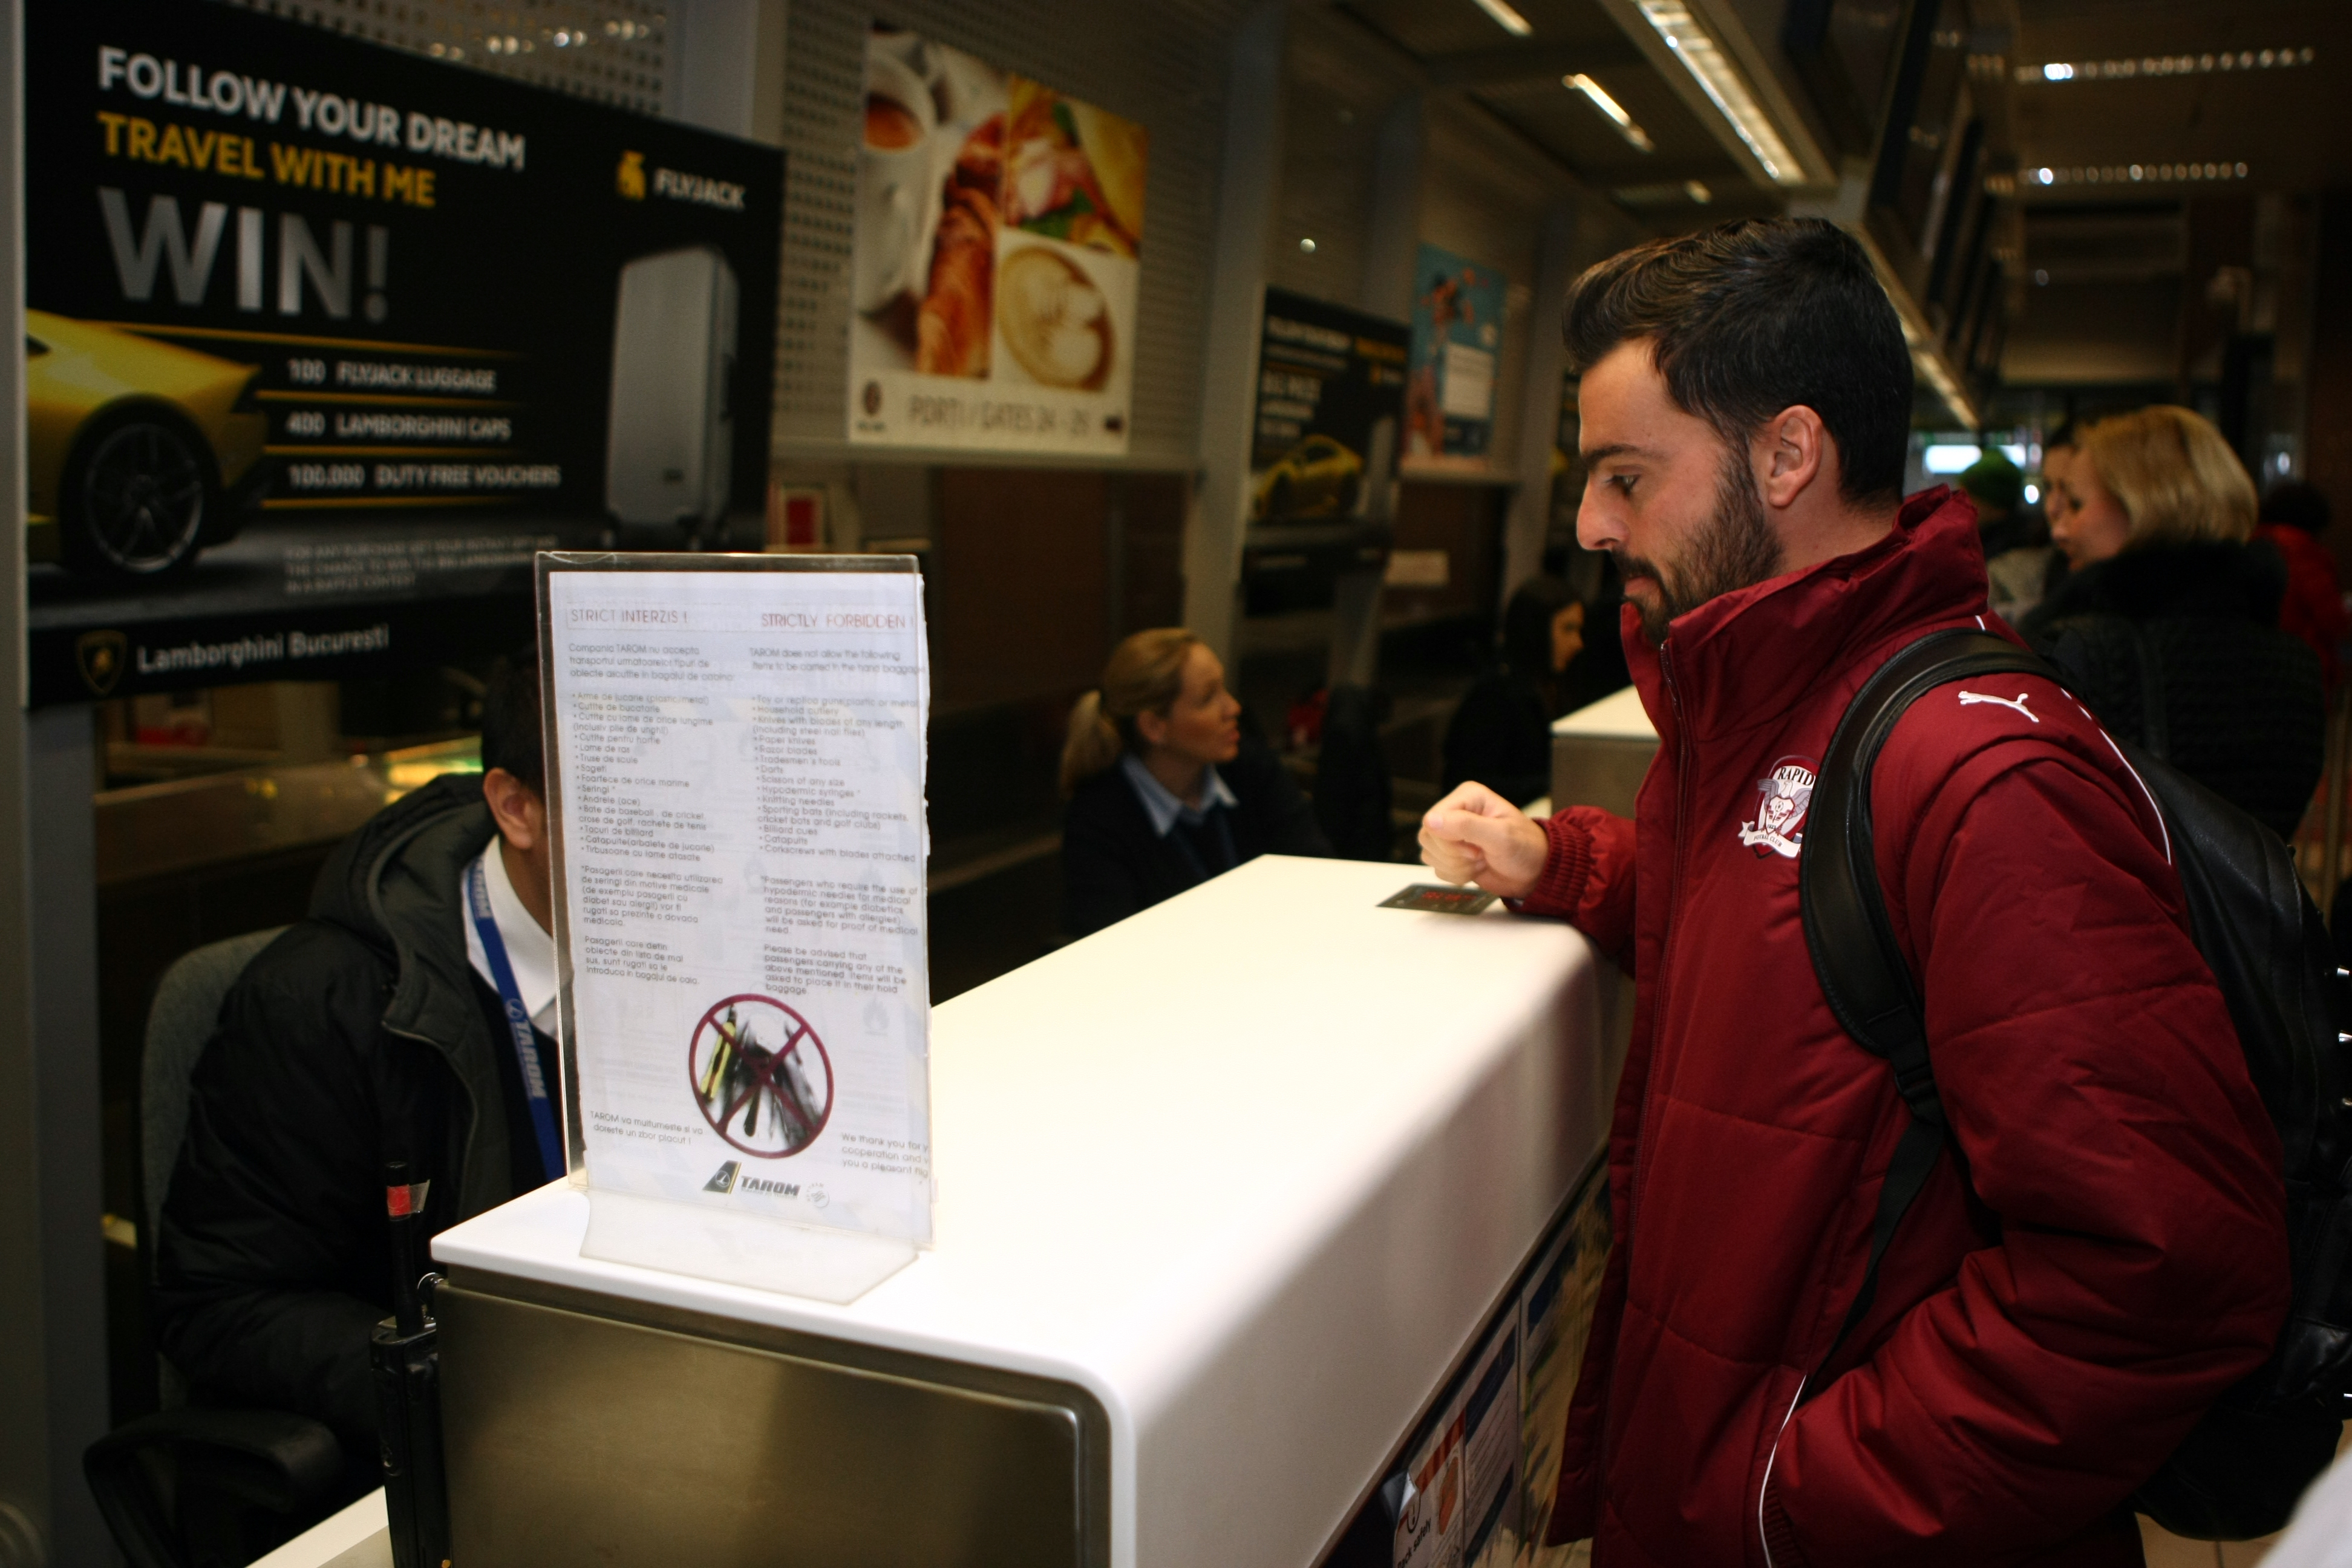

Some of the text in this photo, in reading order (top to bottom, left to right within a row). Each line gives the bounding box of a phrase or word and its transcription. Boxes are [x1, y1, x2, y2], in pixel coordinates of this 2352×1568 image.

[99, 44, 526, 172] FOLLOW YOUR DREAM
[97, 110, 436, 207] TRAVEL WITH ME
[654, 167, 746, 211] FLYJACK
[97, 185, 390, 324] WIN!
[288, 359, 326, 384] 100
[287, 413, 511, 440] 400 LAMBORGHINI CAPS
[572, 609, 615, 622] STRICT
[622, 610, 678, 623] INTERZIS
[762, 613, 906, 629] STRICTLY FORBIDDEN
[137, 633, 283, 674] Lamborghini
[617, 644, 647, 654] TAROM
[580, 743, 603, 753] Lame
[1777, 767, 1815, 786] RAPID
[785, 908, 835, 921] passengers
[765, 943, 793, 954] Please
[809, 949, 846, 959] advised
[765, 953, 814, 967] passengers
[515, 1019, 547, 1098] TAROM
[590, 1111, 619, 1123] TAROM
[638, 1129, 656, 1140] zbor
[659, 1134, 687, 1145] placut
[859, 1134, 884, 1146] thank
[887, 1138, 906, 1149] you
[841, 1145, 900, 1161] cooperation
[842, 1158, 913, 1174] you pleasant
[742, 1175, 801, 1196] TAROM
[1413, 1517, 1431, 1552] safely
